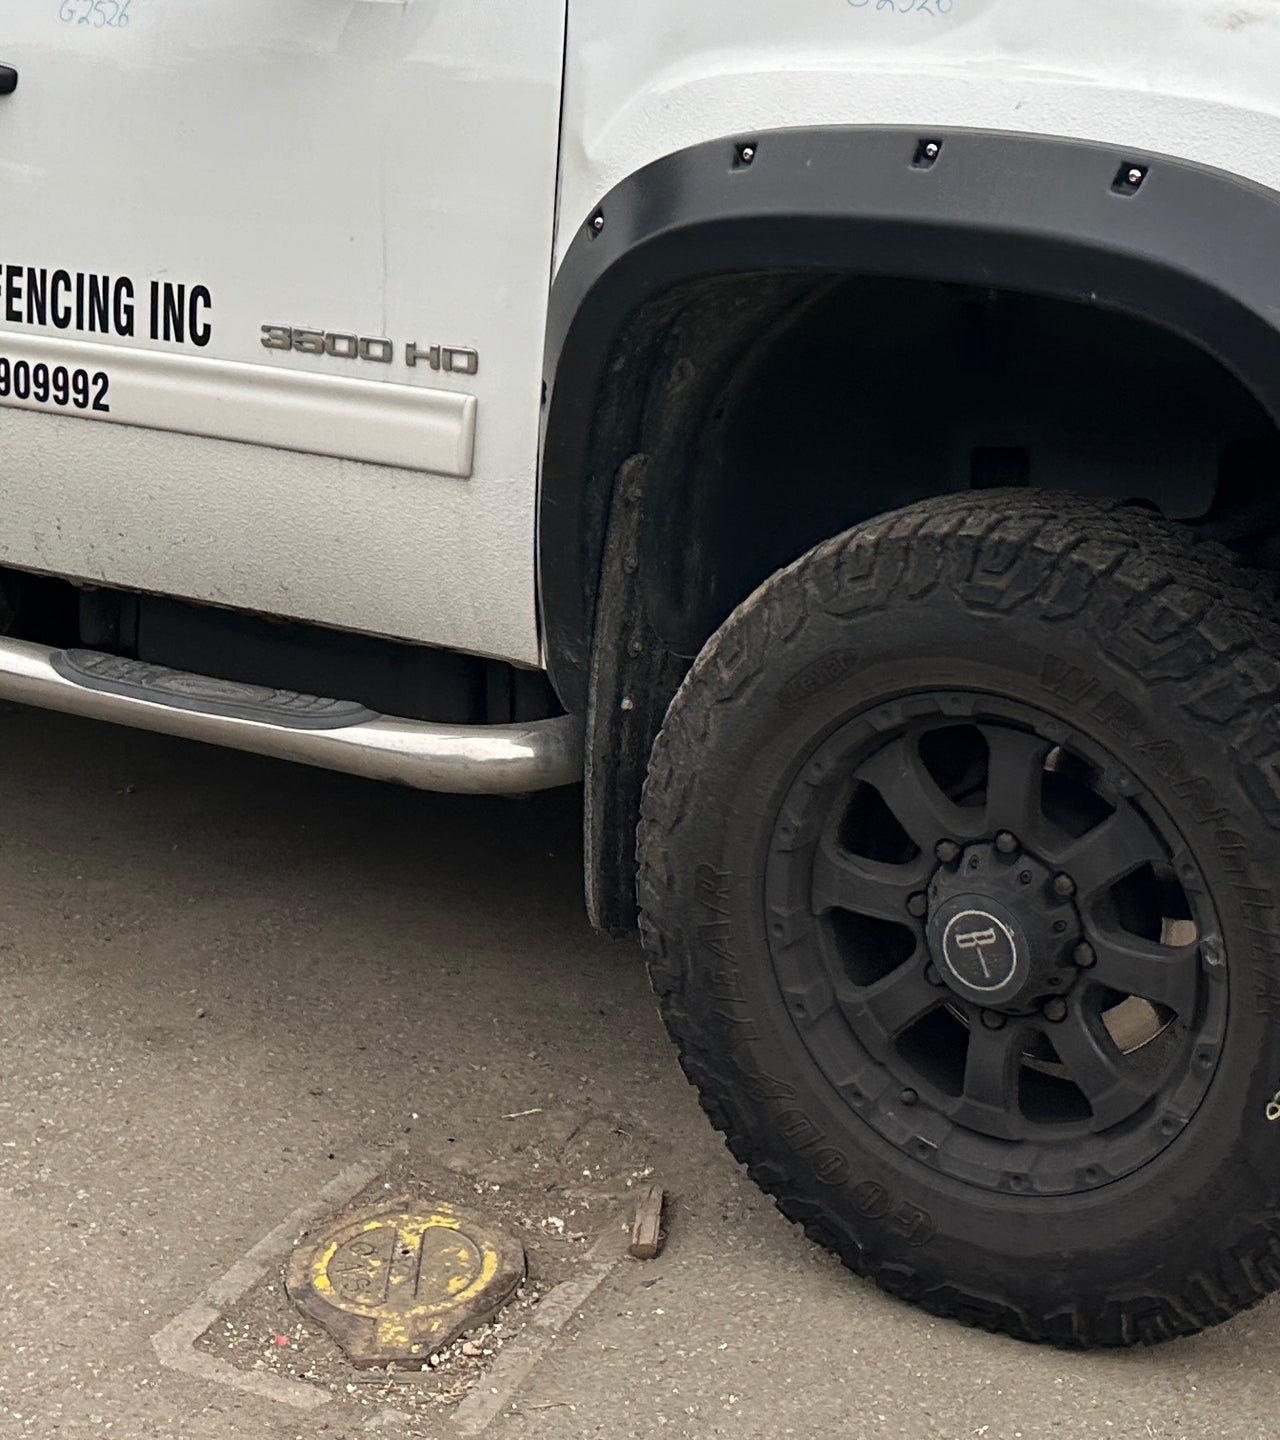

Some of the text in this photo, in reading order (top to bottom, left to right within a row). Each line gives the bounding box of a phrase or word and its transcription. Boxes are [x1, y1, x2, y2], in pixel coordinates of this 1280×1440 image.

[150, 281, 212, 347] INC
[260, 324, 479, 376] 3500 HD
